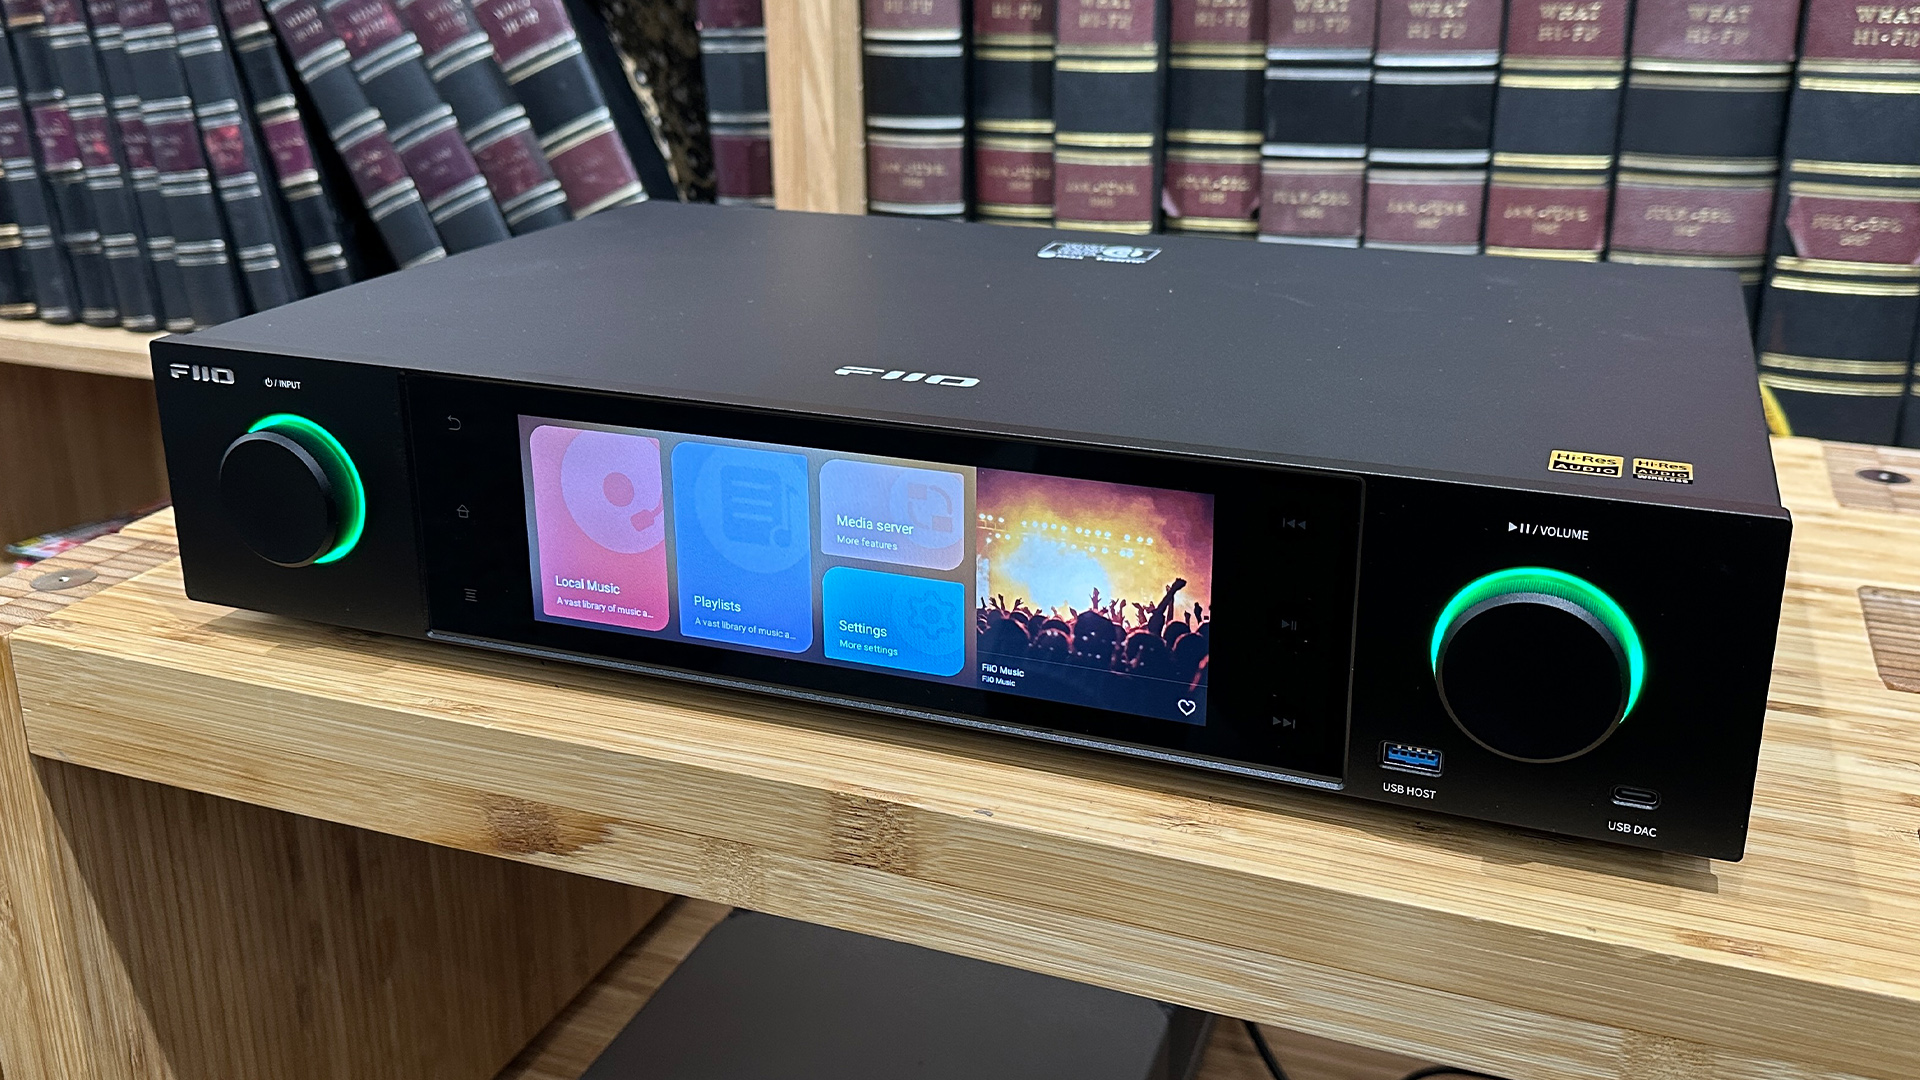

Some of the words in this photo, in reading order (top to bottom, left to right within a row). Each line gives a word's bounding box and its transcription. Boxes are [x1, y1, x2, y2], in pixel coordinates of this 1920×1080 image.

[1408, 0, 1469, 18] WHAT
[1539, 2, 1601, 21] WHAT
[1687, 3, 1751, 23] WHAT
[1557, 453, 1617, 465] Hi-Res
[1638, 460, 1687, 470] Hi-Res
[1555, 463, 1616, 474] AUDIO
[1637, 469, 1688, 478] AUDIO
[836, 514, 873, 530] Media
[876, 521, 914, 535] server
[836, 534, 859, 545] More
[861, 537, 898, 551] features
[555, 575, 585, 590] Local
[586, 579, 621, 595] Music
[556, 596, 564, 605] A
[564, 598, 581, 608] vast
[582, 599, 606, 613] library
[607, 604, 616, 612] of
[617, 606, 642, 616] music
[694, 595, 742, 613] Playlists
[694, 617, 702, 625] A
[703, 619, 720, 628] vast
[721, 620, 747, 634] library
[748, 625, 756, 633] of
[758, 627, 783, 638] music
[839, 619, 887, 639] Settings
[839, 639, 862, 650] More
[863, 644, 899, 657] settings
[999, 665, 1025, 678] Music
[995, 677, 1016, 687] Music
[1383, 781, 1405, 794] USB
[1406, 786, 1437, 800] HOST
[1608, 820, 1632, 833] USB
[1633, 825, 1657, 838] DAC
